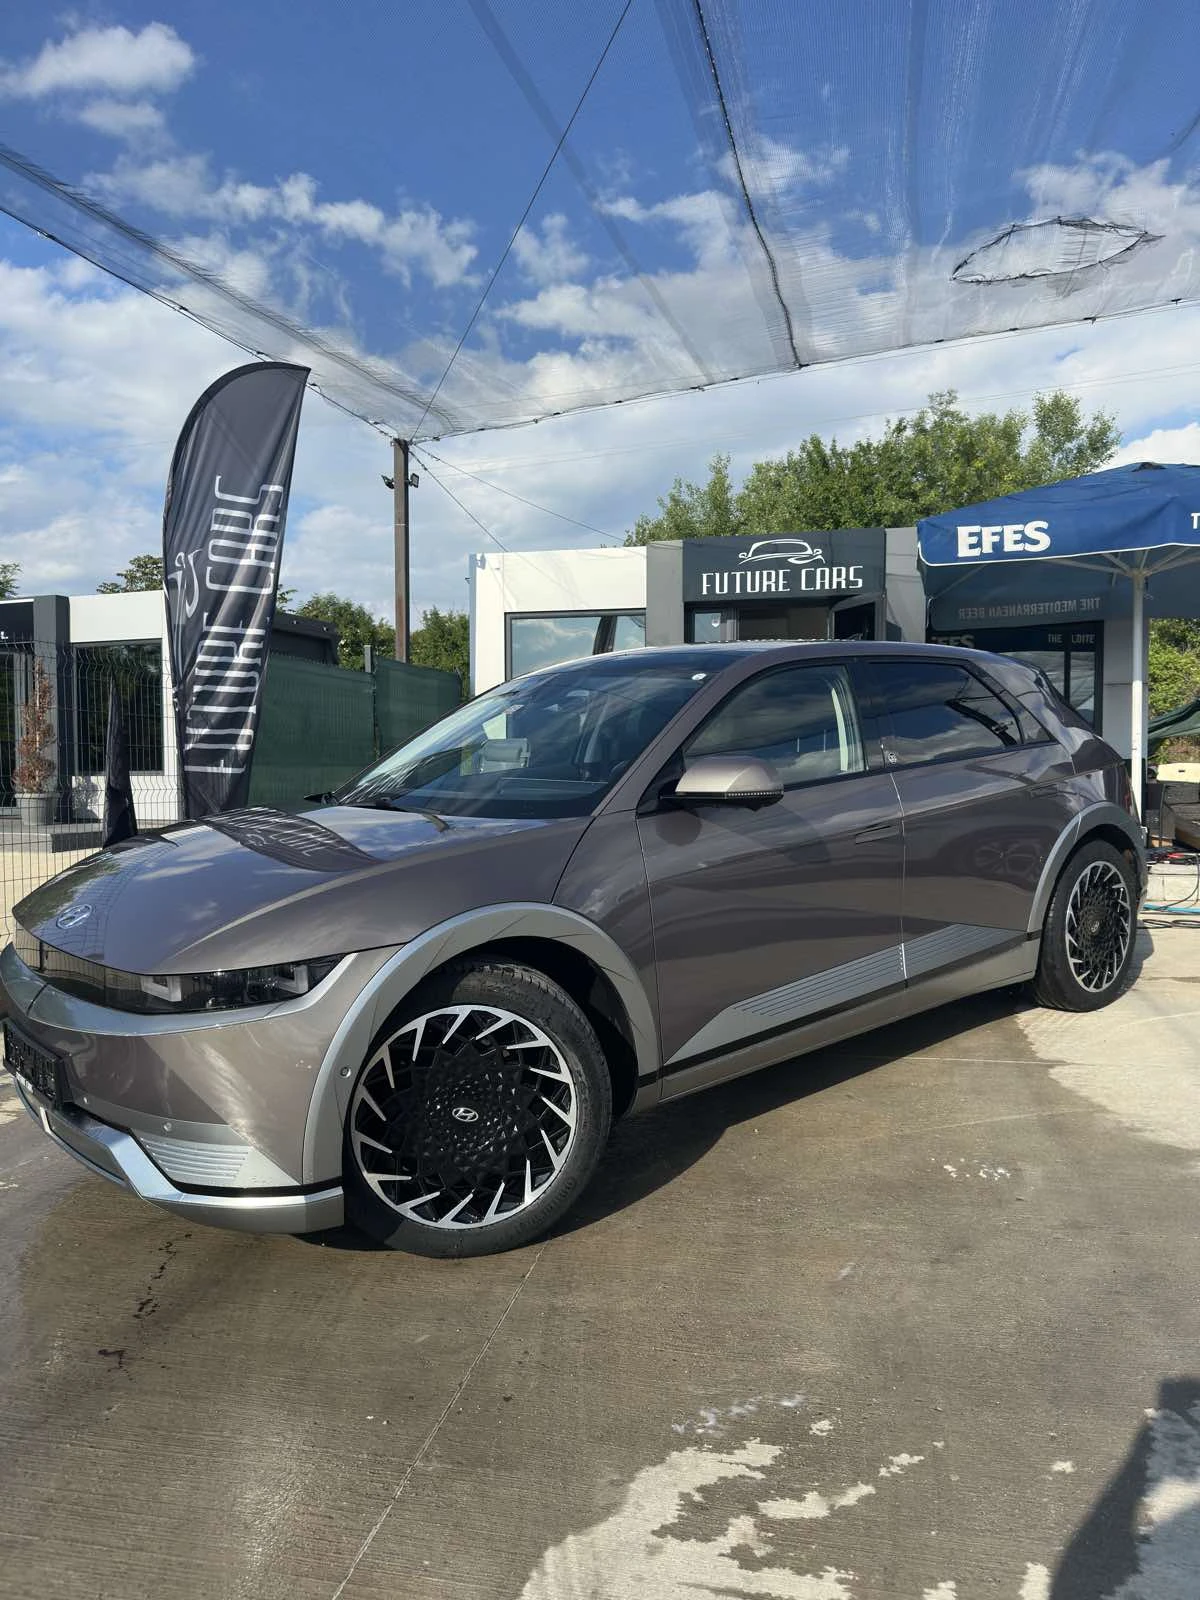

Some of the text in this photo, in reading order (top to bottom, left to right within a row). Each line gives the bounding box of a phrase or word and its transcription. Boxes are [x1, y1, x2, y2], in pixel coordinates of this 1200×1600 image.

[957, 520, 1051, 557] EFES
[702, 565, 864, 595] FUTURE CARS
[184, 475, 284, 774] FUTURE CARS
[1048, 633, 1063, 644] THE
